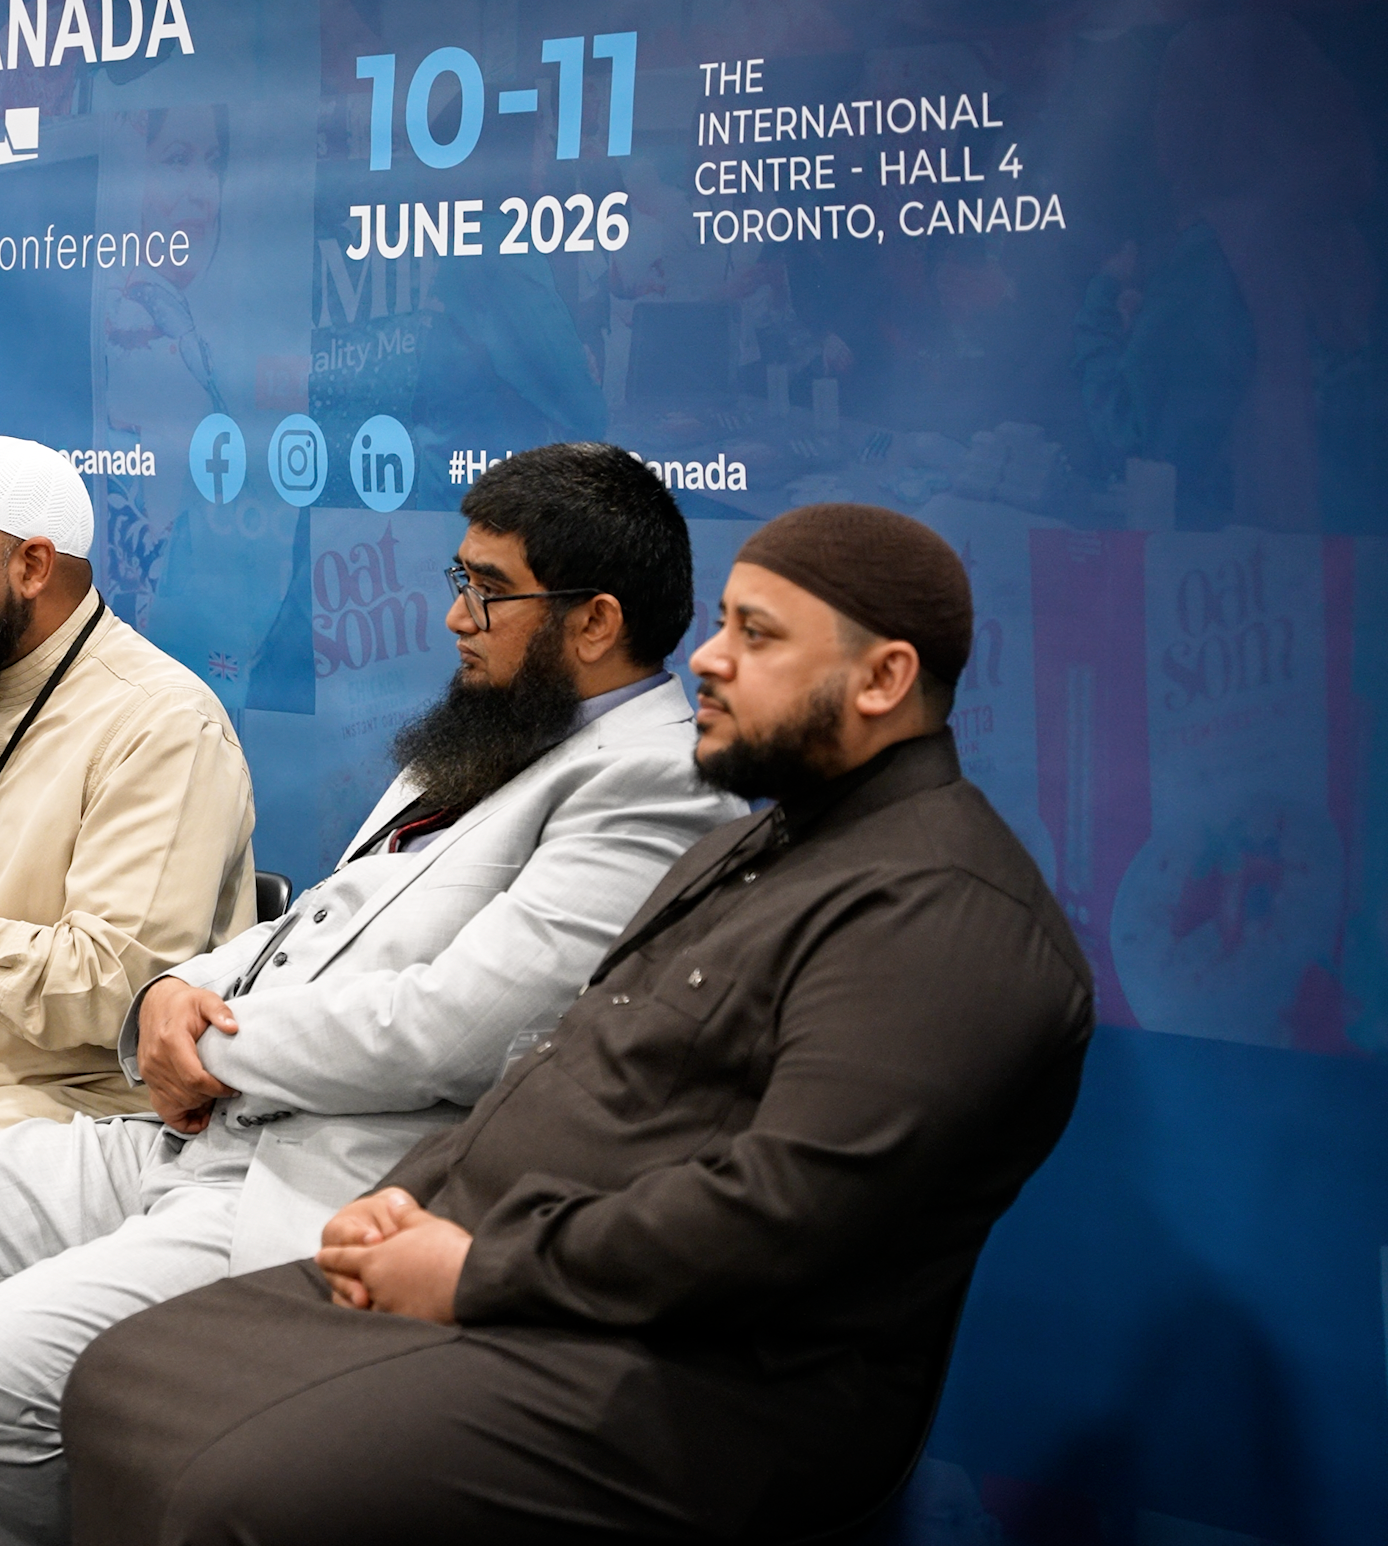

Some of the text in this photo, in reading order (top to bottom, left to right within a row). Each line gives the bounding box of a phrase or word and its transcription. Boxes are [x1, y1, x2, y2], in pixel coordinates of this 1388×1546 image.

[357, 31, 637, 171] 10-11
[699, 58, 764, 97] THE
[698, 92, 1003, 147] INTERNATIONAL
[694, 153, 835, 196] CENTRE
[880, 146, 984, 186] HALL
[998, 142, 1024, 180] 4
[345, 191, 630, 261] JUNE 2026
[693, 194, 1066, 245] TORONTO, CANADA
